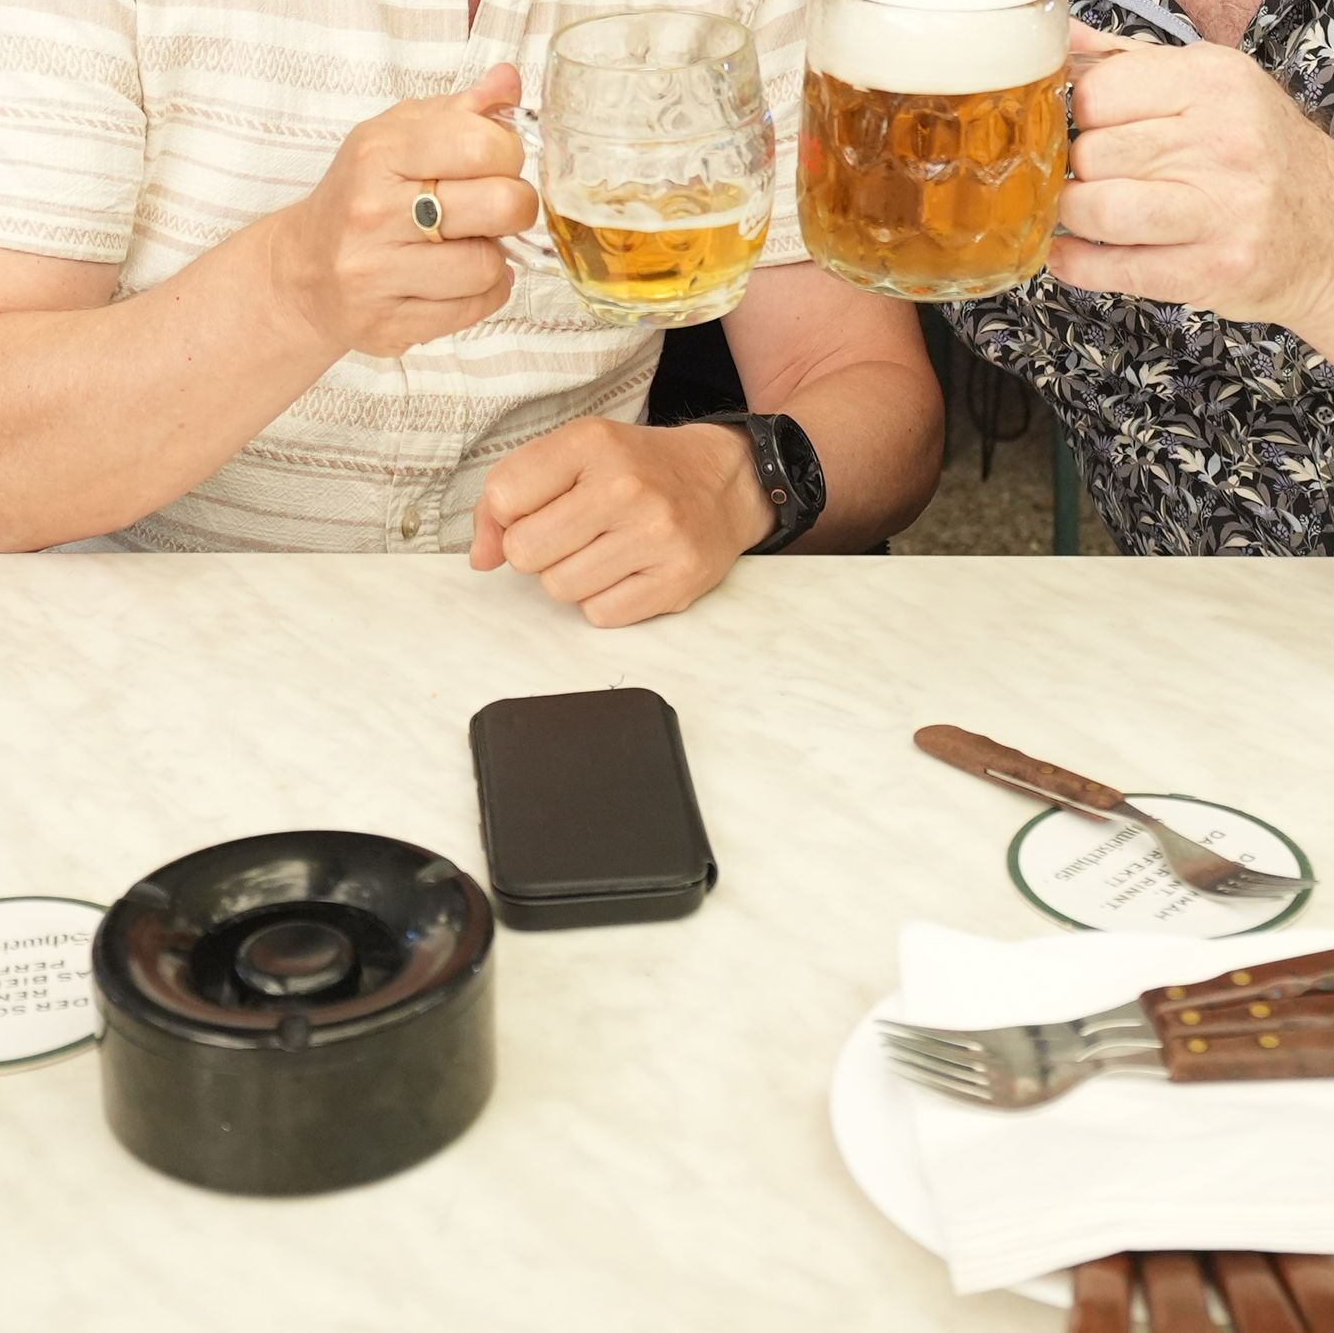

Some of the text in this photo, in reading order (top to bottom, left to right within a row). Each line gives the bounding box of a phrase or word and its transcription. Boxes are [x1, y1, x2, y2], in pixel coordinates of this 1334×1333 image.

[1198, 830, 1226, 846] DA
[1103, 849, 1165, 888] RFEKT!
[58, 970, 94, 983] AS
[36, 996, 89, 1013] DER
